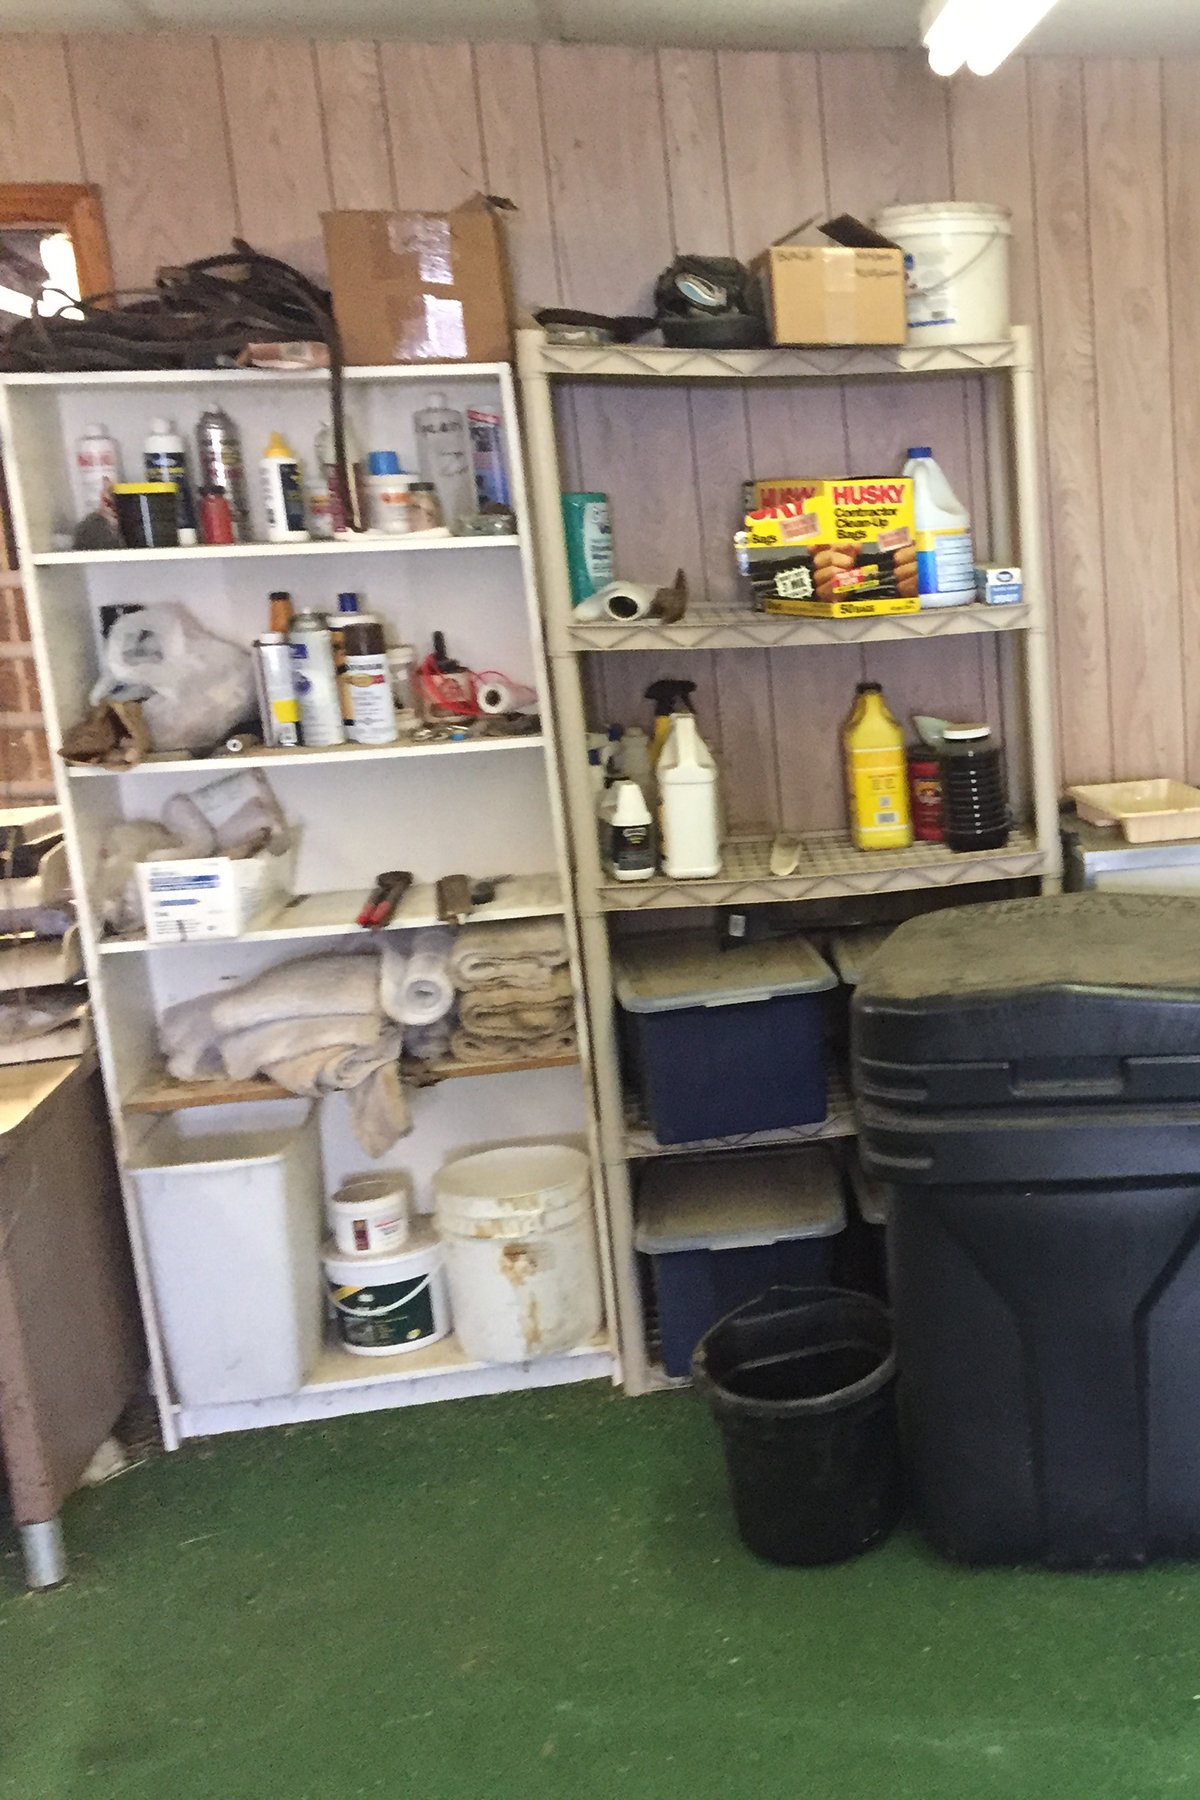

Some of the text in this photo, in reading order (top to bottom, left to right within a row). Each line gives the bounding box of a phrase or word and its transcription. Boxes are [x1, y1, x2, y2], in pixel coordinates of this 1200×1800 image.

[833, 484, 905, 505] HUSKY
[834, 507, 898, 518] Contractor
[835, 518, 889, 529] Clean-Up
[836, 529, 867, 541] Bags
